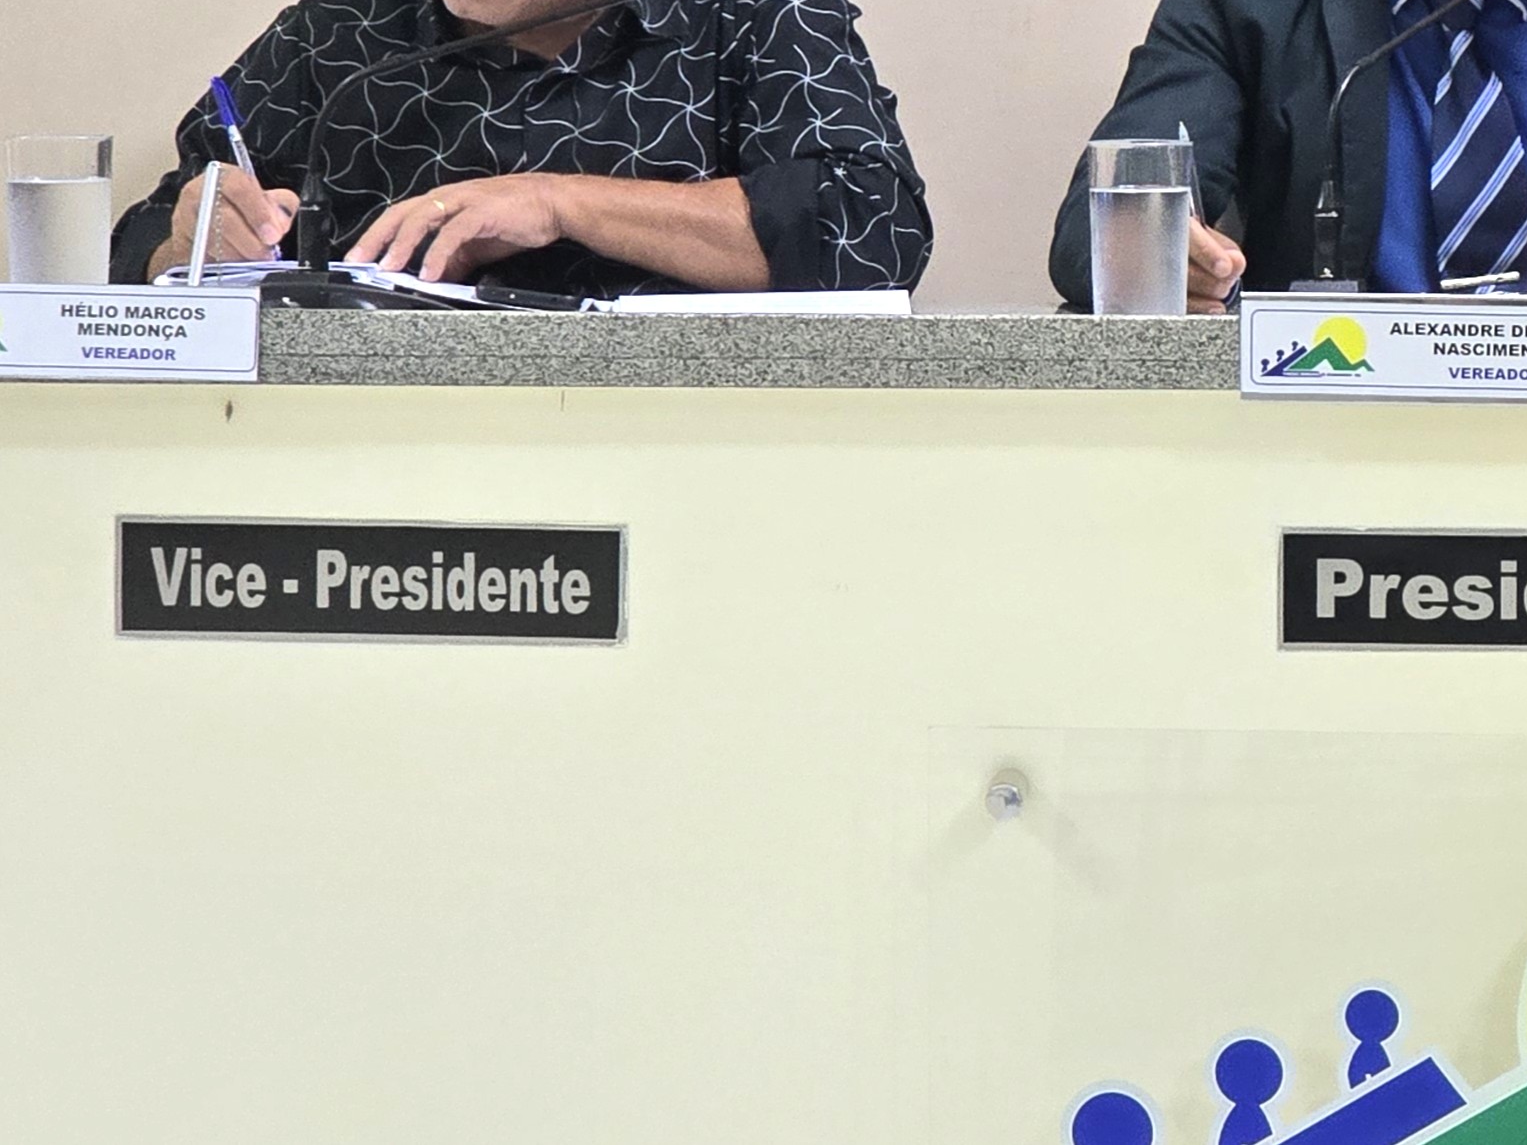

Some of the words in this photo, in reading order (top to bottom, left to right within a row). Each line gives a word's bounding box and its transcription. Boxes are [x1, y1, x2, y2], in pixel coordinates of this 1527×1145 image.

[60, 301, 119, 319] HÉLIO
[124, 306, 206, 321] MARCOS
[77, 322, 188, 342] MENDONÇA
[1389, 322, 1505, 338] ALEXANDRE
[81, 346, 176, 361] VEREADOR
[150, 546, 267, 609] Vice
[316, 549, 592, 615] Presidente
